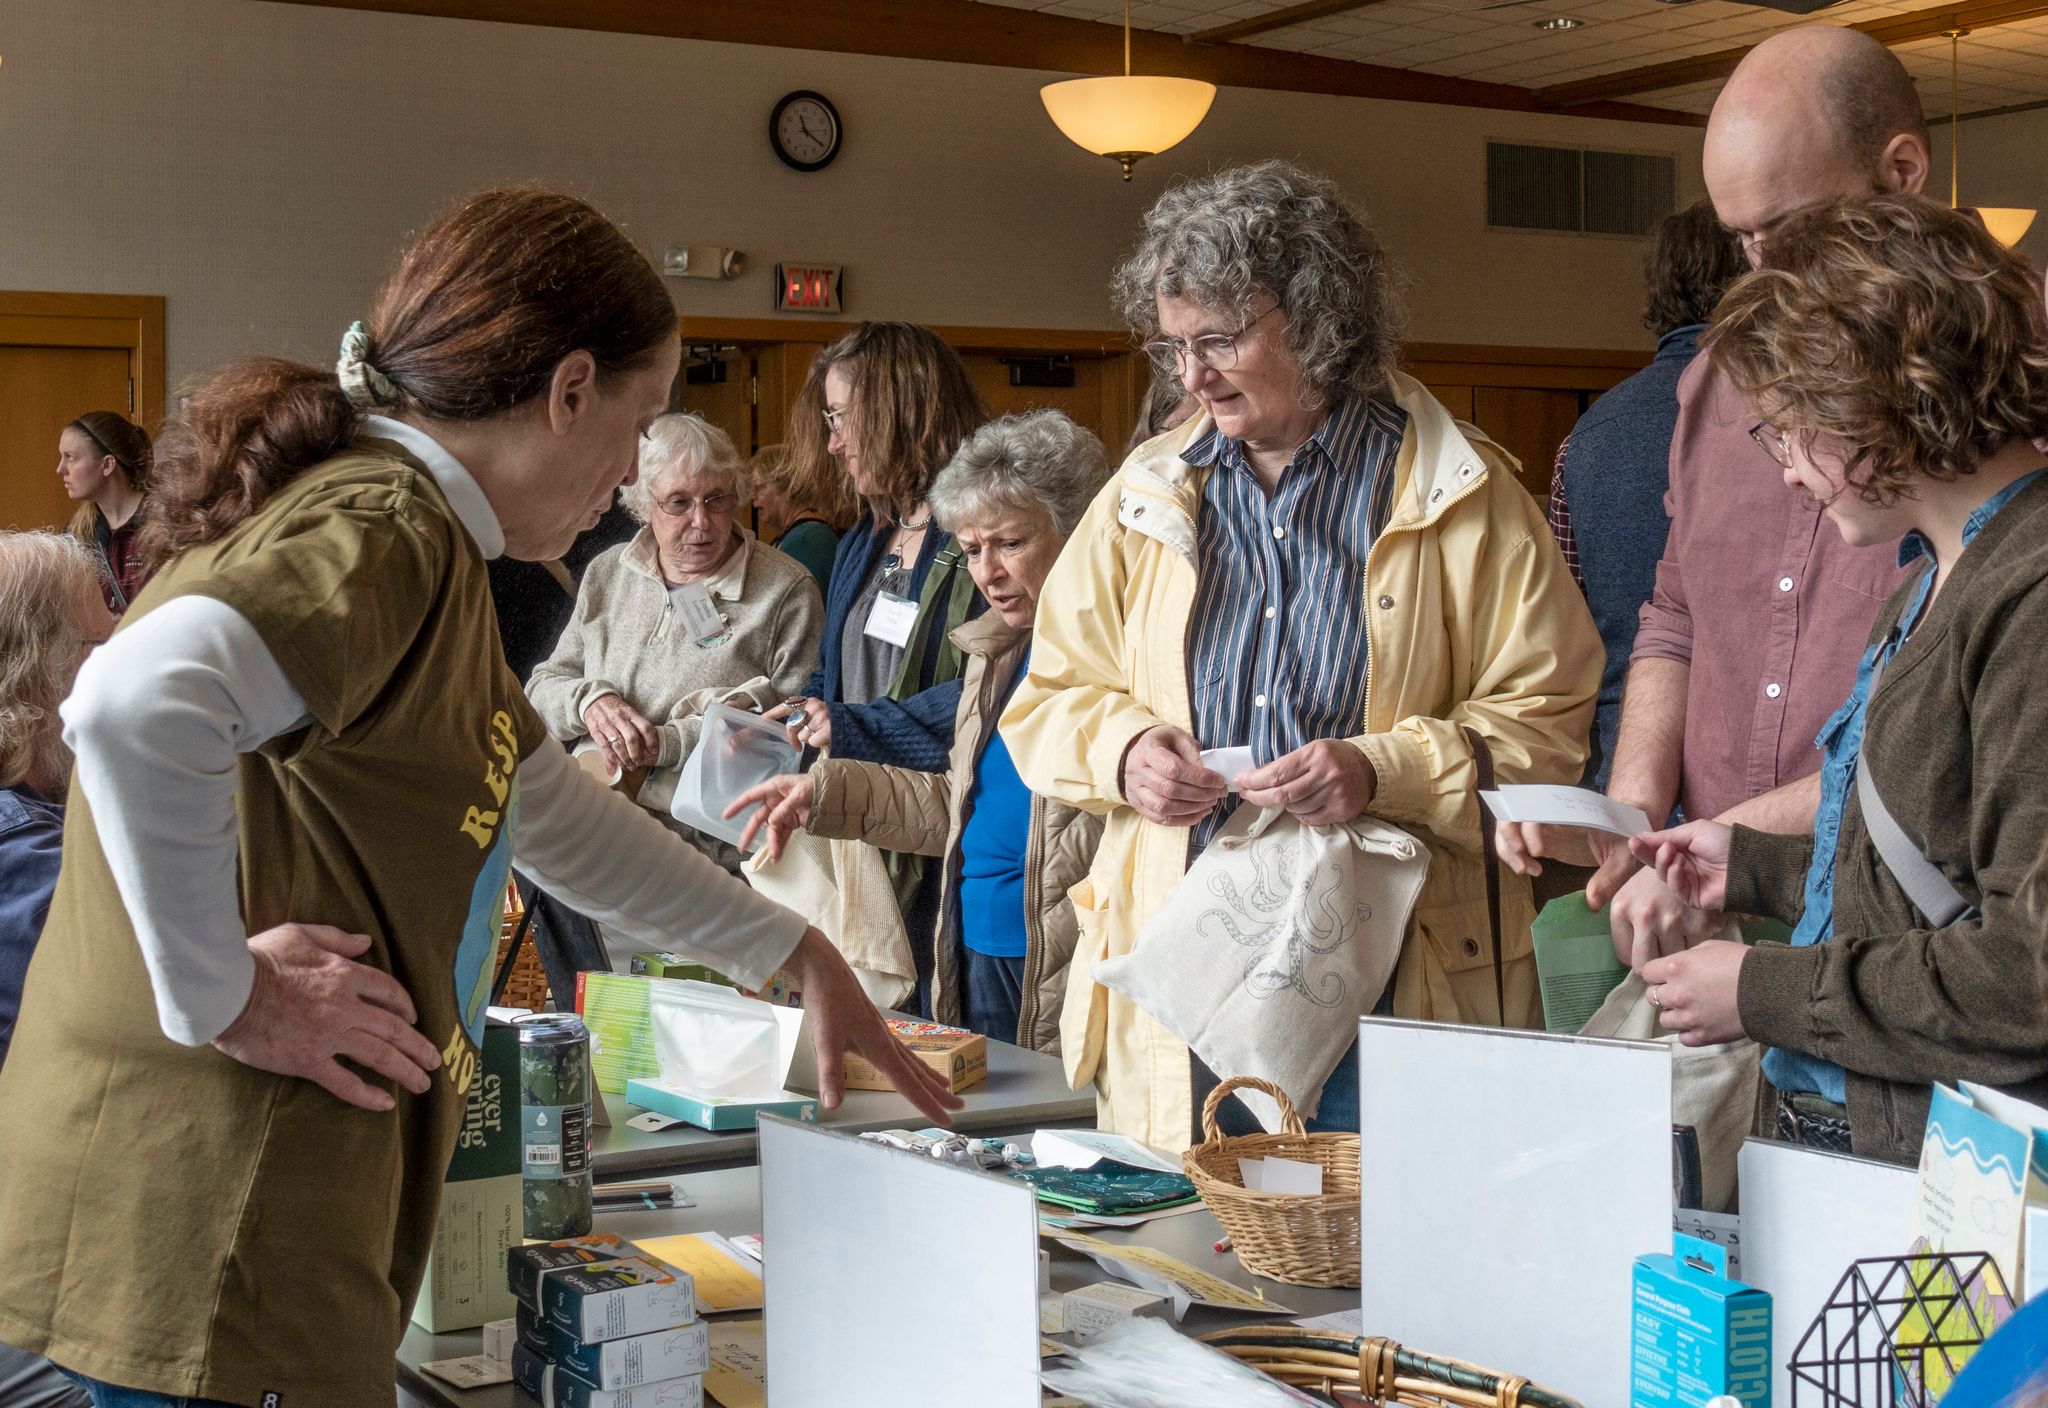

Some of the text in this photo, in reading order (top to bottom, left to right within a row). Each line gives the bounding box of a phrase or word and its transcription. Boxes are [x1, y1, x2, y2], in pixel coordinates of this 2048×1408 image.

[787, 268, 834, 307] EXIT
[484, 1074, 502, 1132] ever
[1635, 1313, 1661, 1329] EASY
